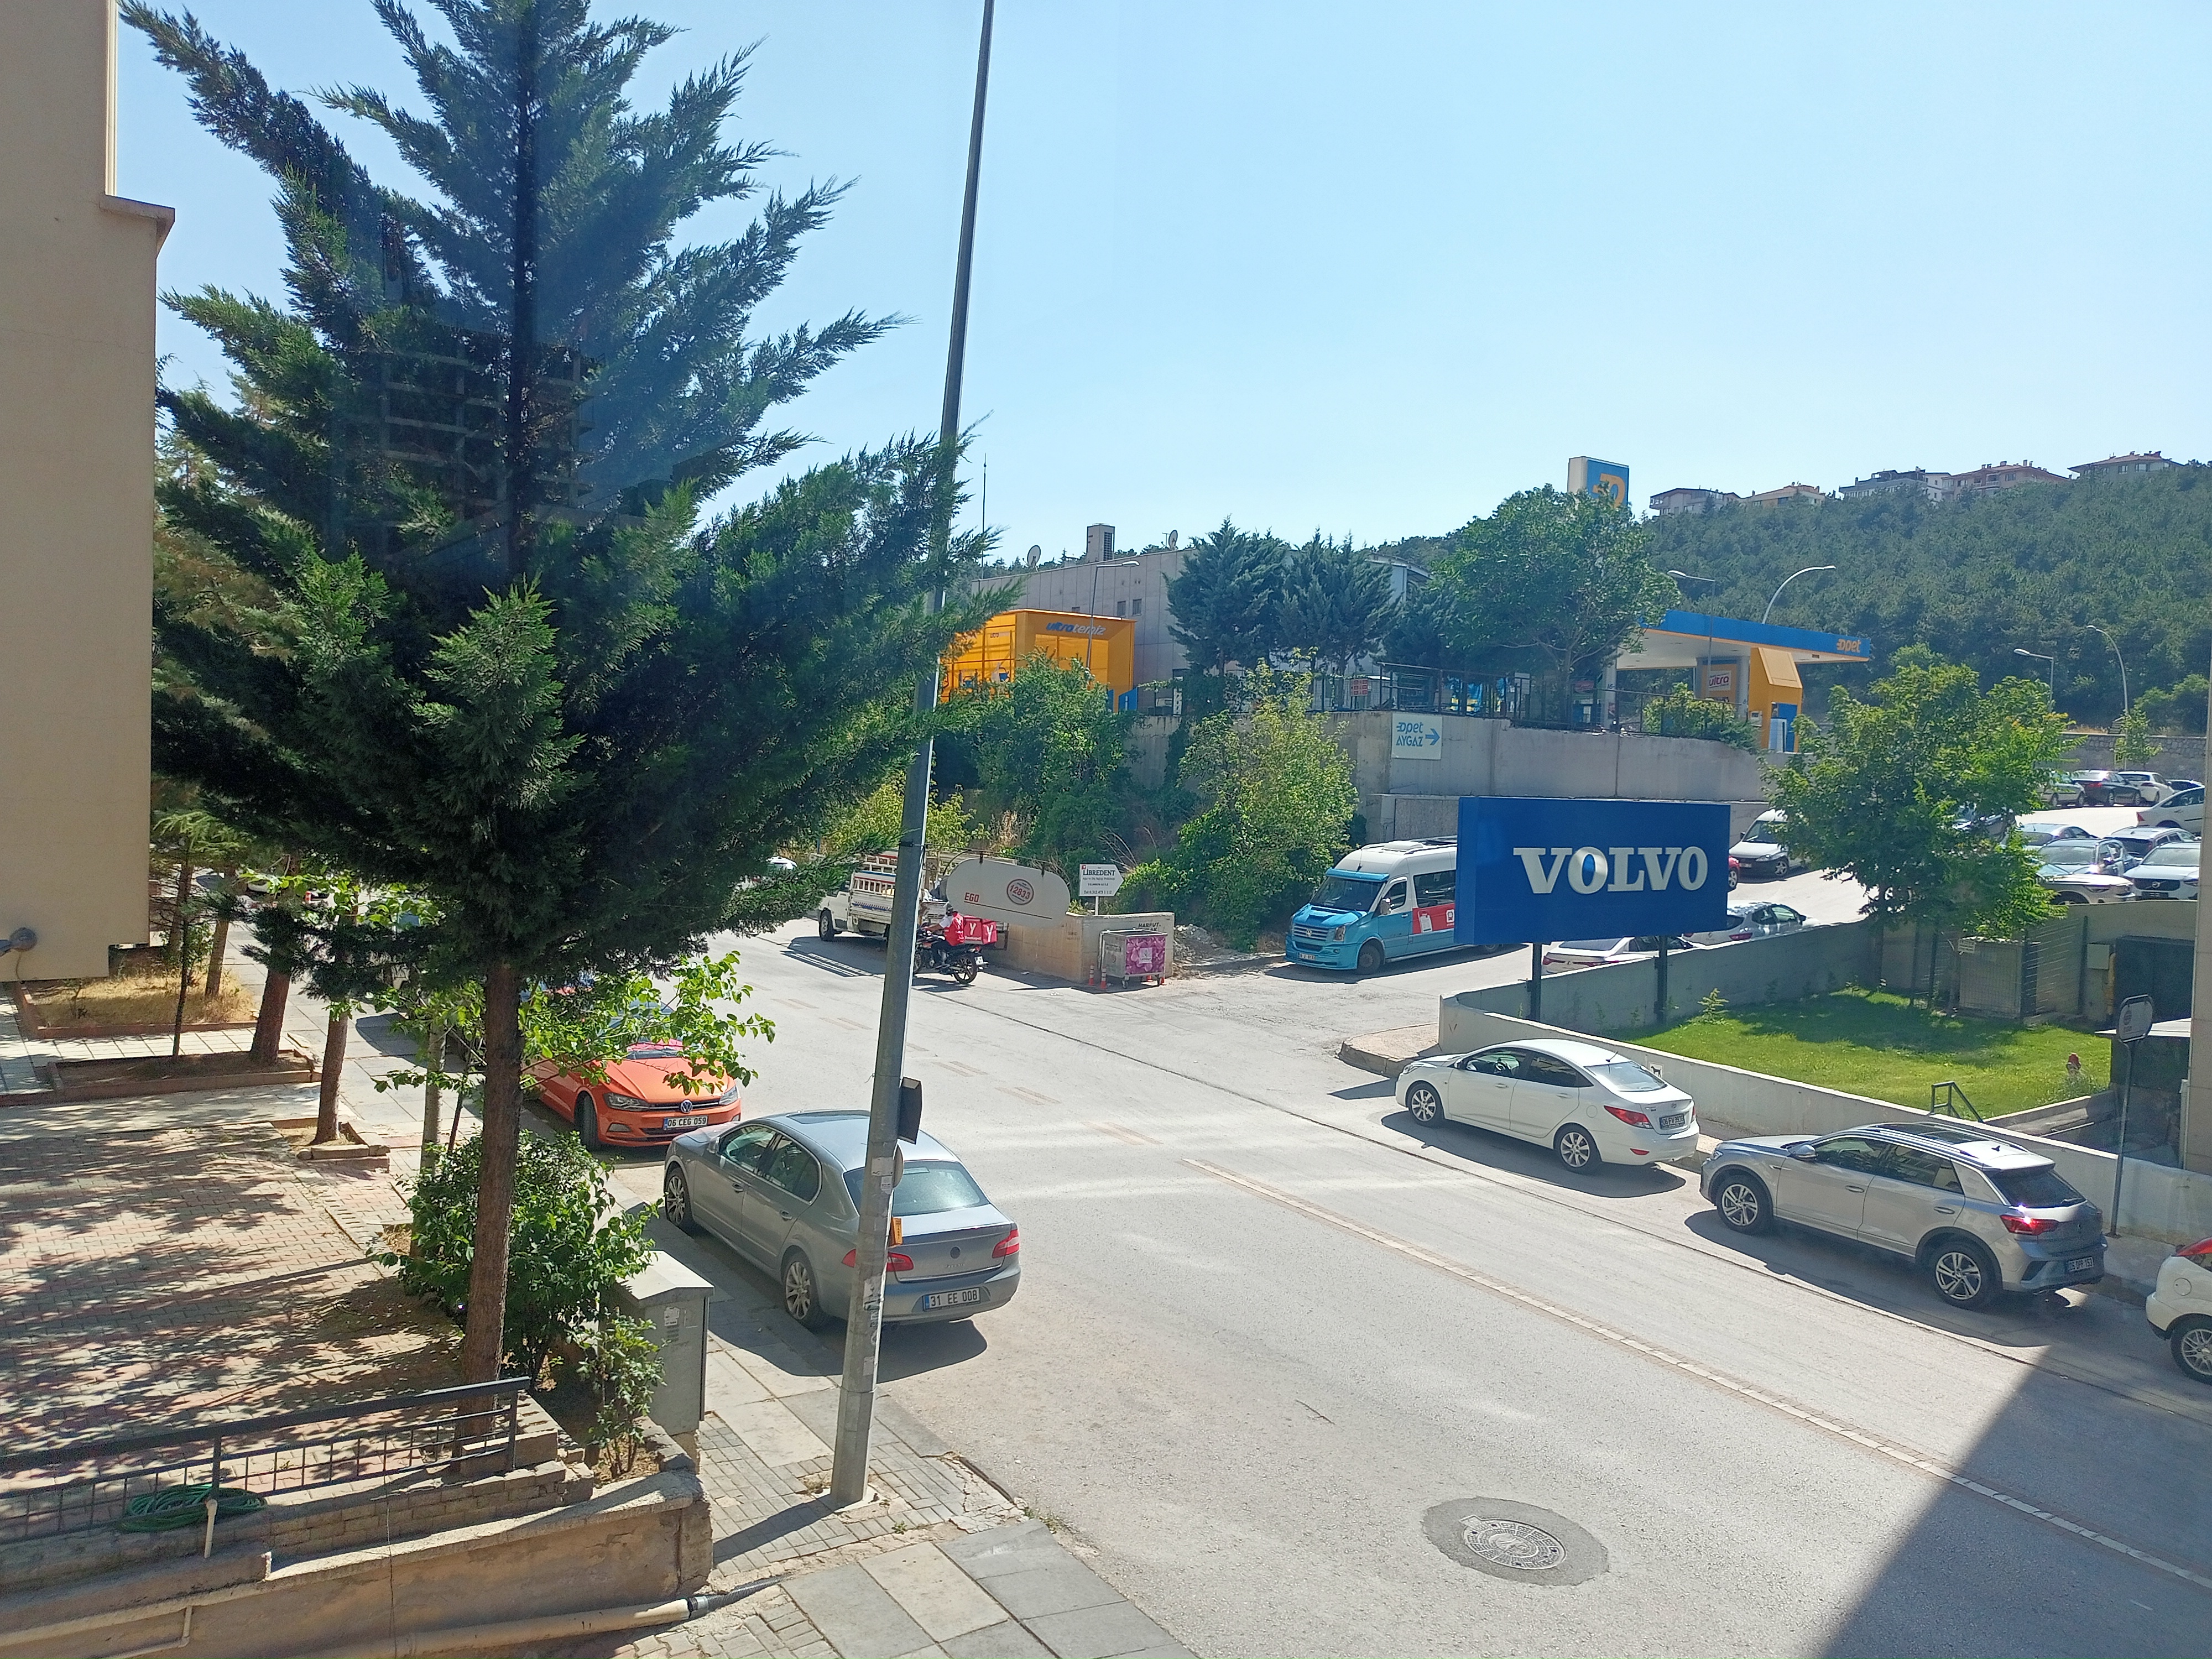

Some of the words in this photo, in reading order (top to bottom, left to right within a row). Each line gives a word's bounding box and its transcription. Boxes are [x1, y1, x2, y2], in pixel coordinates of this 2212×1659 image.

[1709, 676, 1729, 686] ultra
[1396, 722, 1423, 734] opet
[1396, 735, 1423, 747] AYGAZ
[1513, 846, 1708, 894] VOLVO
[964, 892, 979, 902] EGO
[1010, 885, 1031, 899] 12833
[986, 924, 994, 942] Y
[931, 1295, 941, 1306] 31
[947, 1293, 958, 1304] EE
[962, 1290, 978, 1302] 008
